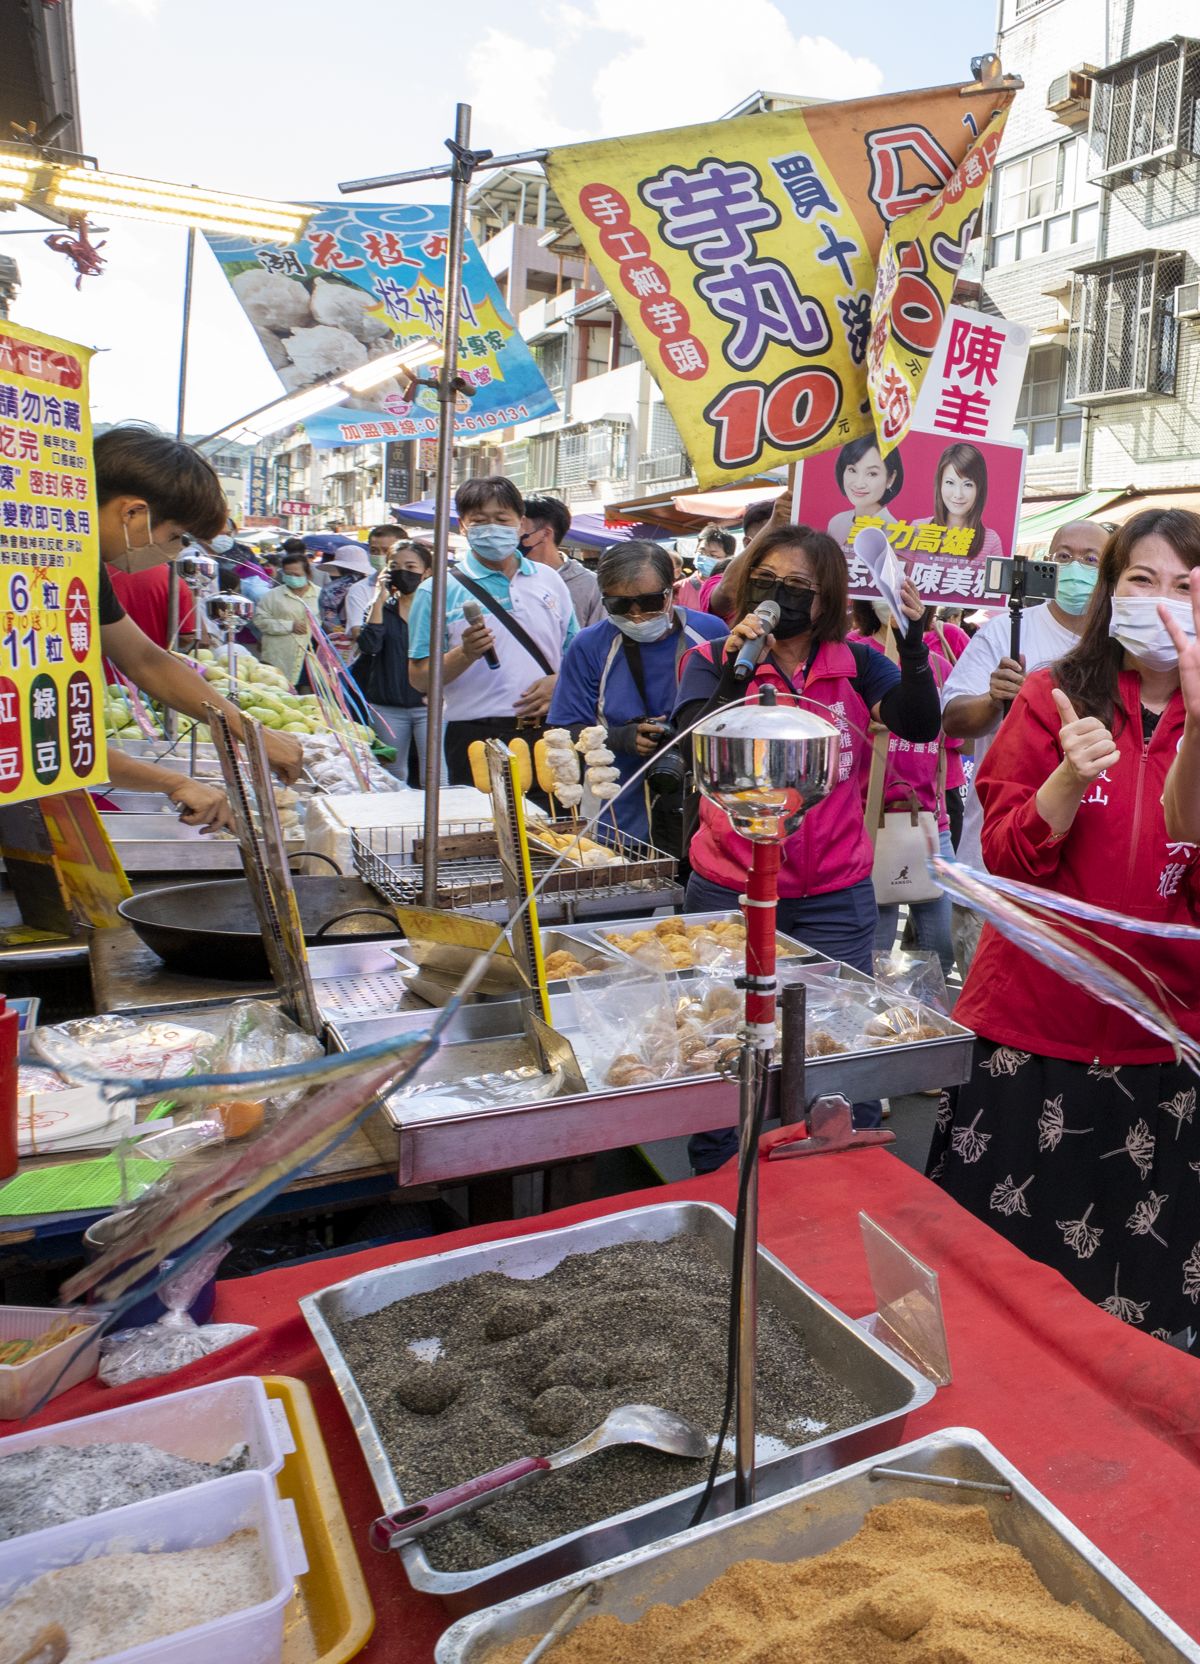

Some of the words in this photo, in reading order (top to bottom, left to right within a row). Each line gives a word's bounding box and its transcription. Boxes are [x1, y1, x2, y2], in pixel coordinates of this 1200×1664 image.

[588, 192, 706, 374] 手工純芋頭
[643, 162, 829, 368] 芋丸
[10, 574, 29, 613] 6
[43, 582, 60, 610] 粒
[68, 588, 89, 652] 大顆
[3, 629, 37, 668] 11
[45, 634, 63, 663] 粒
[33, 687, 60, 774] 綠豆
[69, 681, 92, 768] 巧克力
